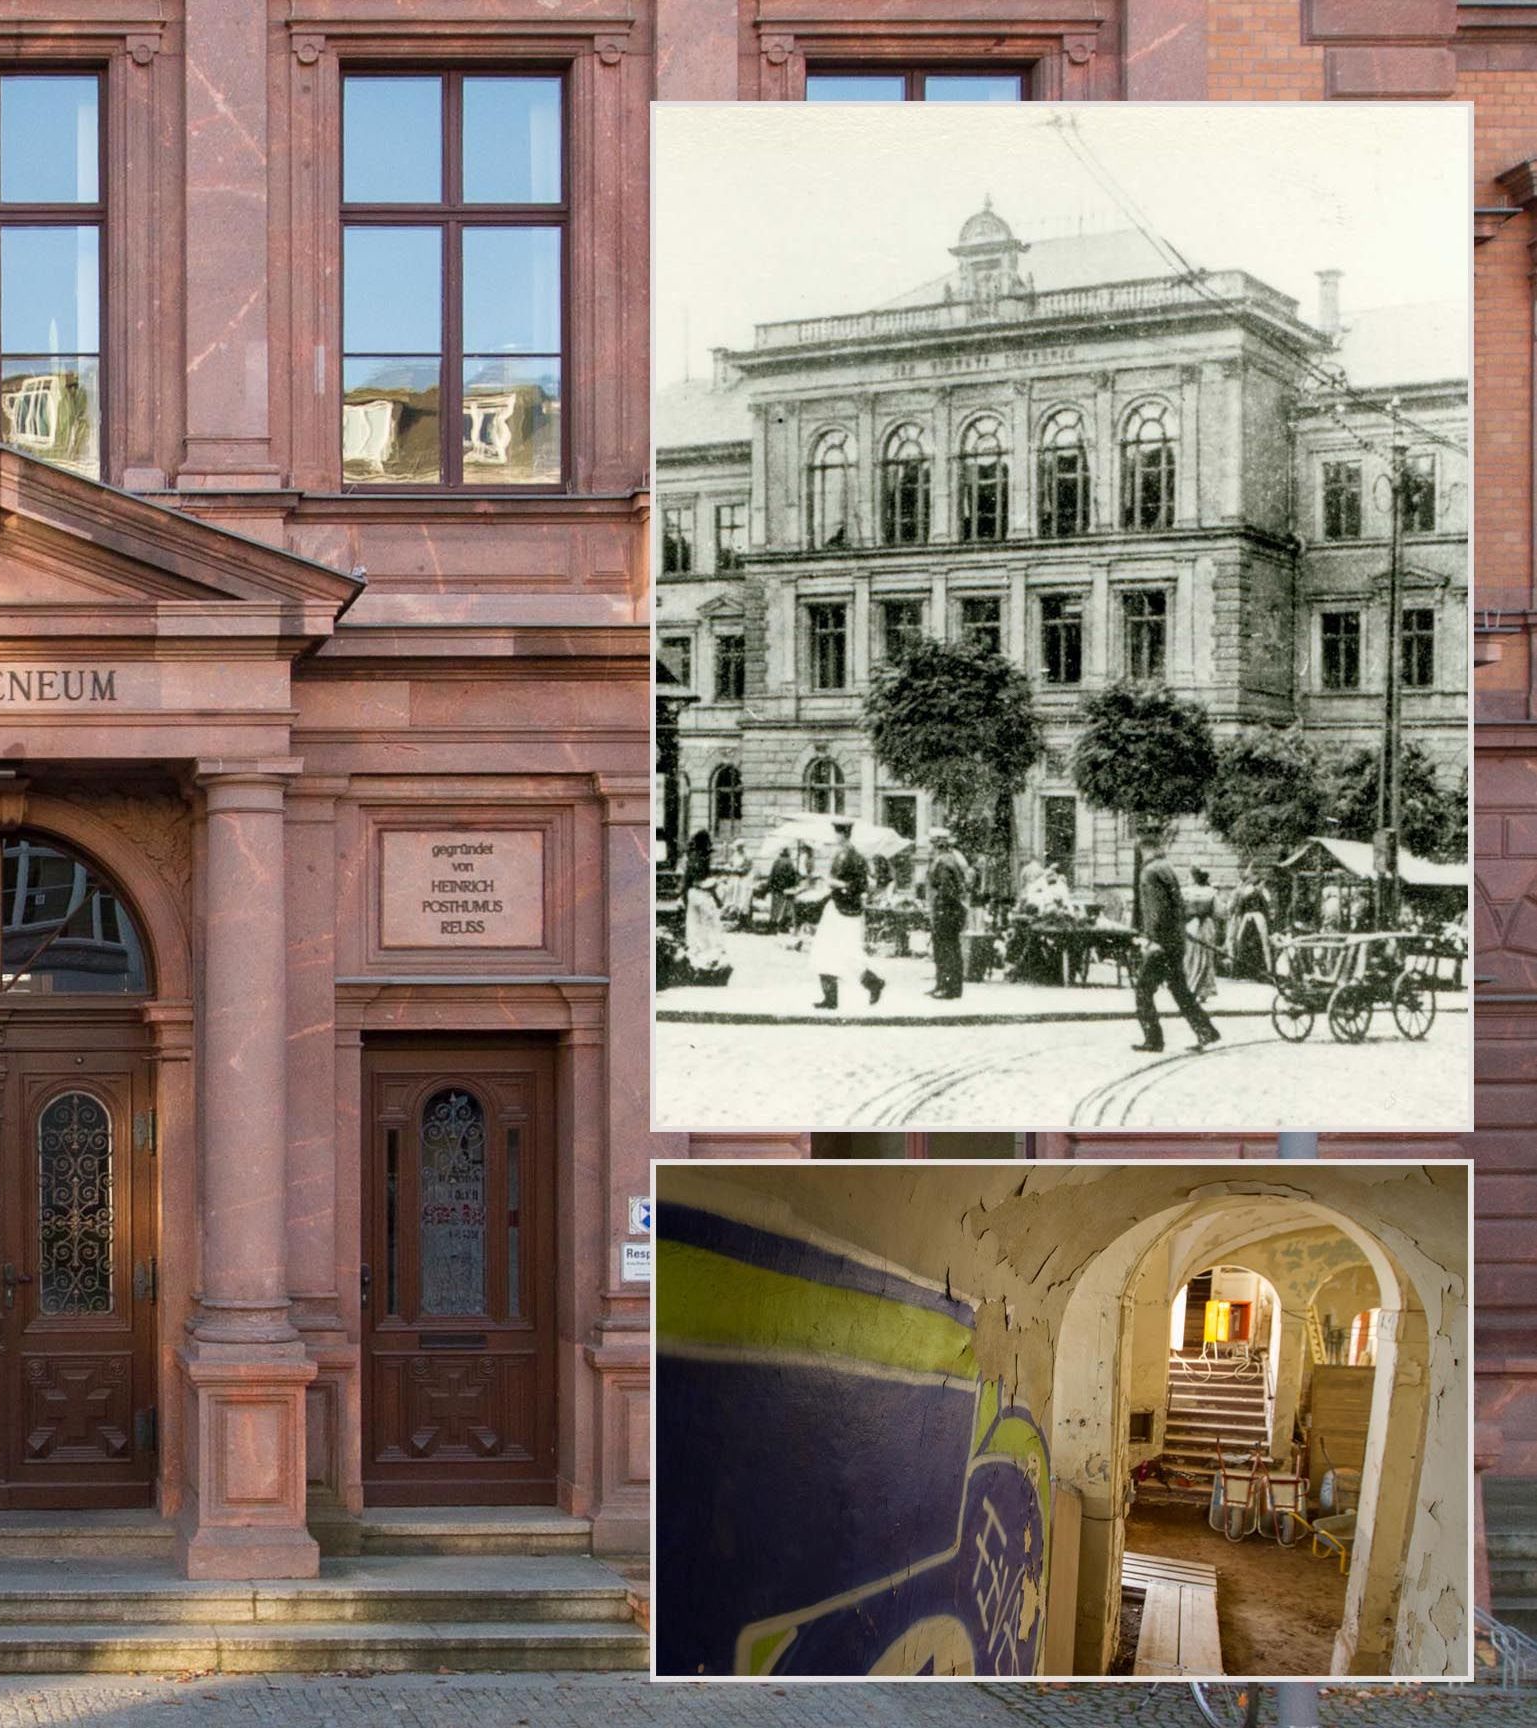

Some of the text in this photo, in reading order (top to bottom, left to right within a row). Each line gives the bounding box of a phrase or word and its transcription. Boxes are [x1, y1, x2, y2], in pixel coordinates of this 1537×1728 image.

[431, 842, 494, 858] gegründet
[451, 862, 474, 873] von
[431, 879, 494, 893] HEINRICH
[421, 900, 504, 914] POSTHUMUS
[440, 920, 486, 935] REUSS
